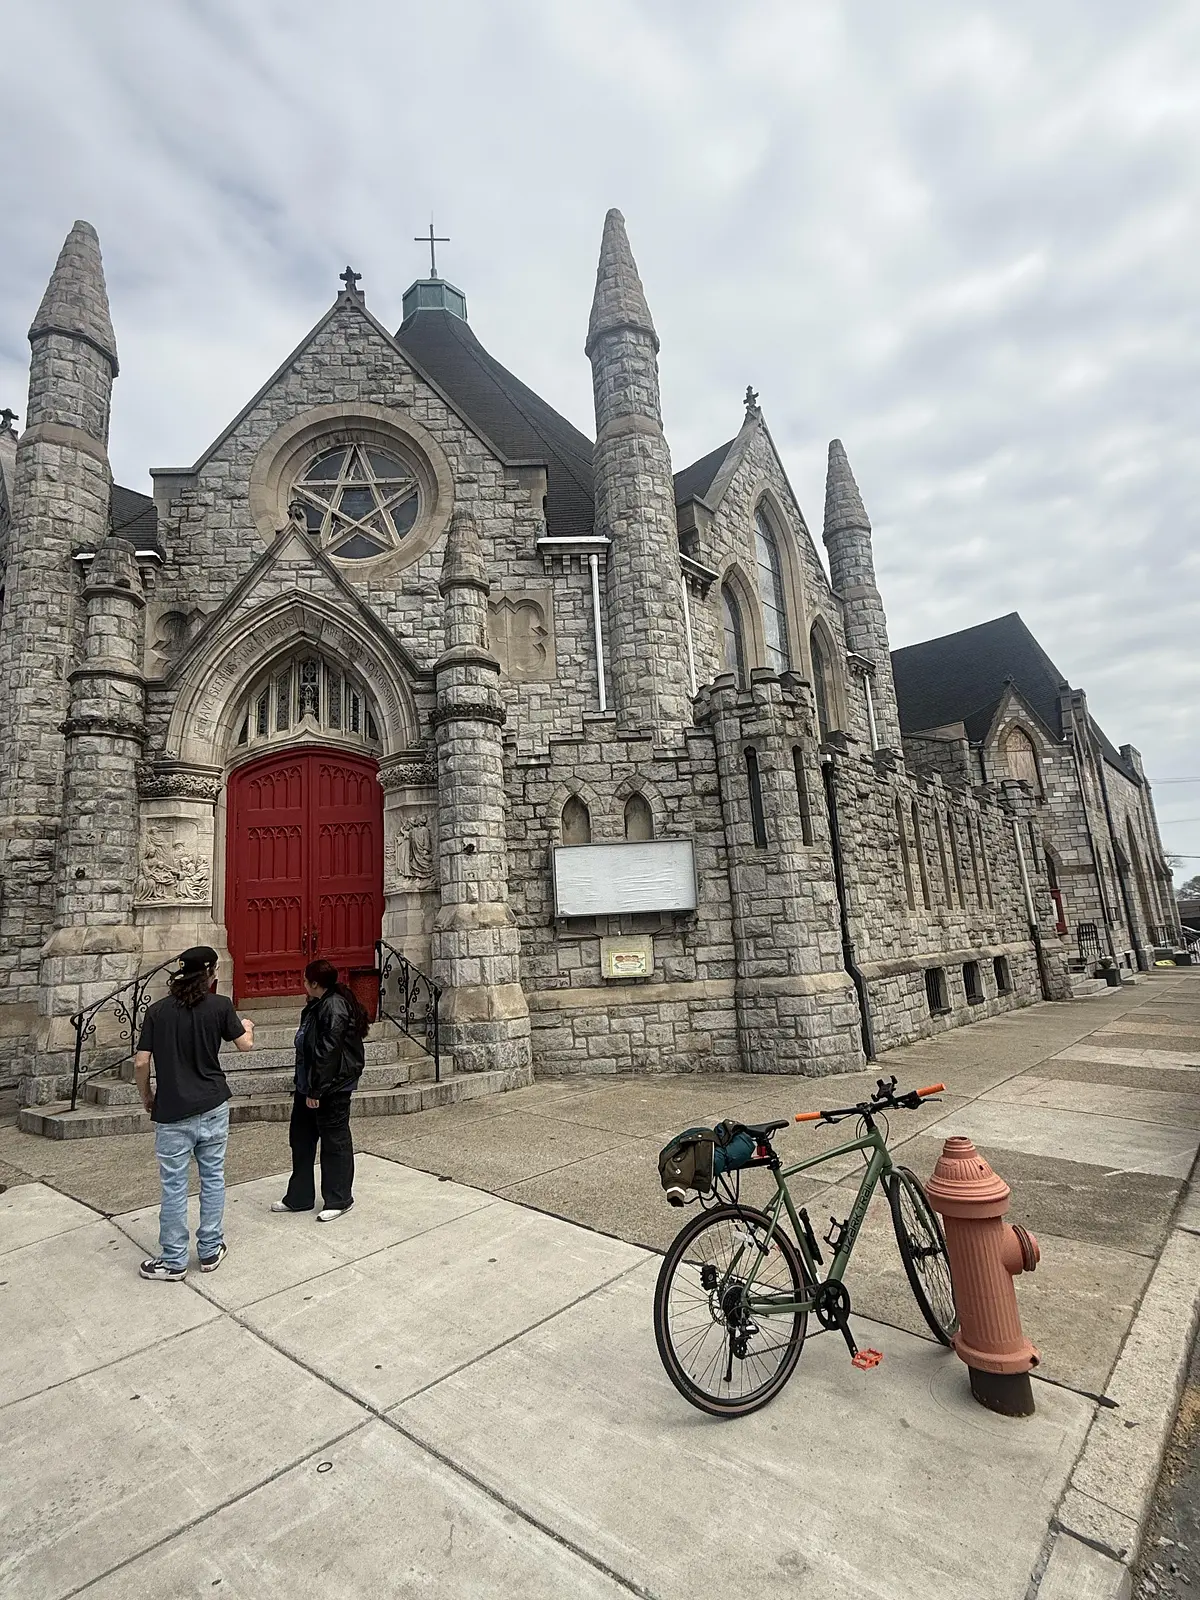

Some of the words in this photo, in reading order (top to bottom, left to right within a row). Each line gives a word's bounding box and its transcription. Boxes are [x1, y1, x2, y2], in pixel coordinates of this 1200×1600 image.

[197, 698, 215, 725] HAVE
[262, 624, 279, 639] THE
[277, 613, 298, 631] EAST
[324, 626, 339, 638] ARE
[365, 657, 376, 672] TO
[373, 669, 397, 709] WORSHIP
